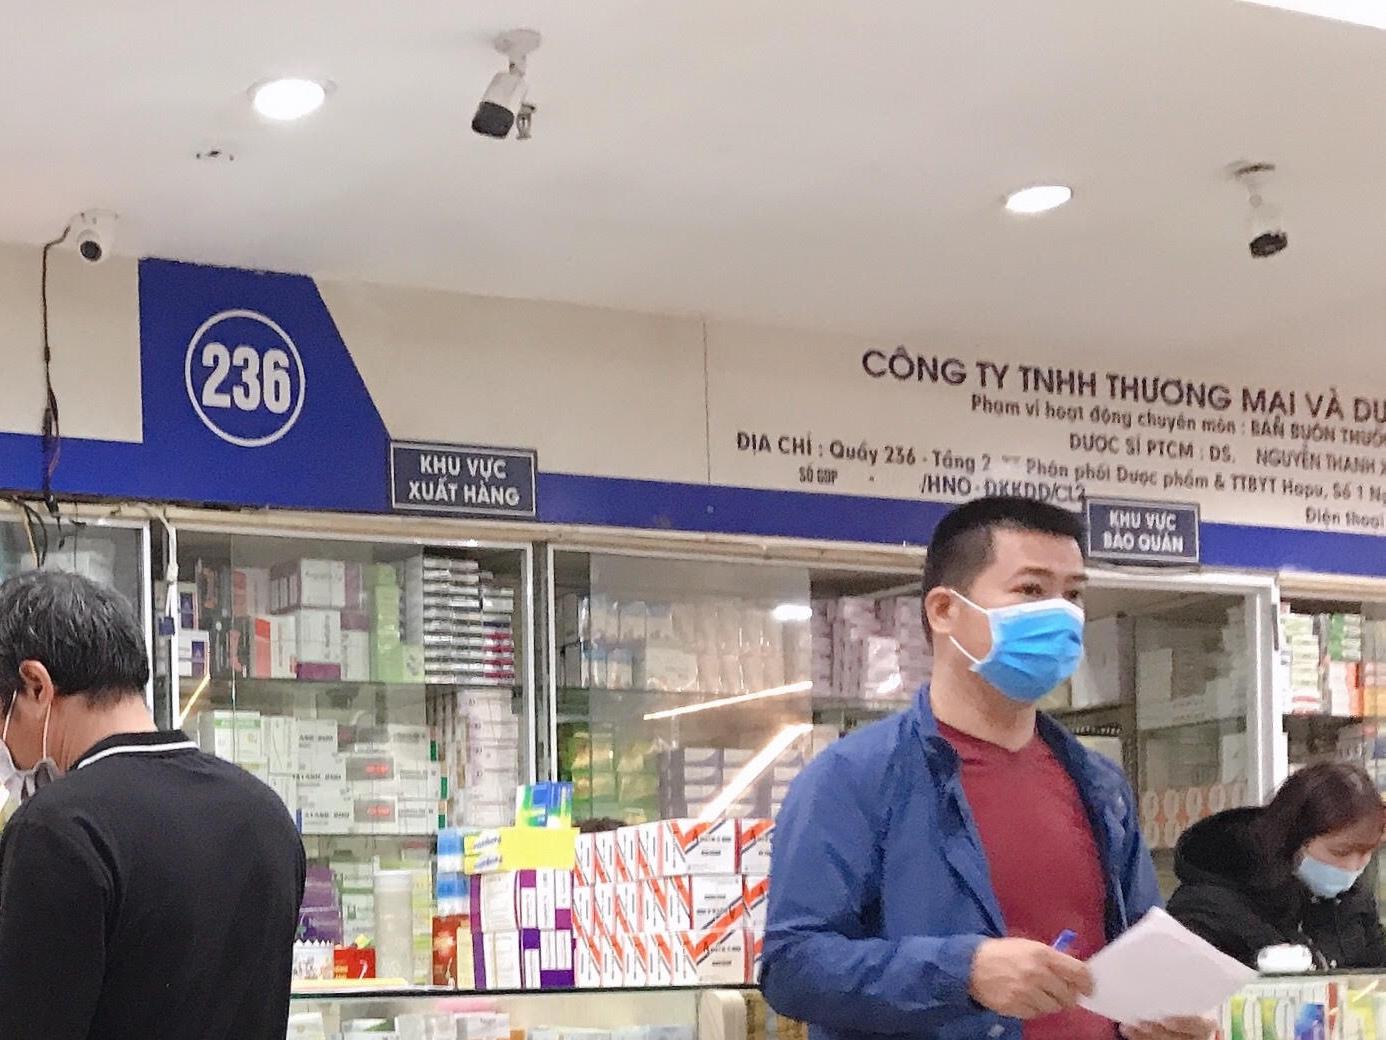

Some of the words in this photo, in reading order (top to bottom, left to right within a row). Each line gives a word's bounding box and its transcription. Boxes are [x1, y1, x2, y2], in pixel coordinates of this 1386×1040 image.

[201, 341, 292, 414] 236
[862, 345, 967, 386] CÔNG
[976, 361, 1010, 389] TY
[1018, 366, 1097, 397] TNHH
[1105, 373, 1233, 411] THƯƠNG
[1304, 387, 1345, 422] VÀ
[419, 454, 461, 477] KHU
[466, 456, 506, 481] VỰC
[408, 475, 459, 503] XUẤT
[464, 478, 520, 506] HÀNG
[1108, 509, 1141, 530] KHU
